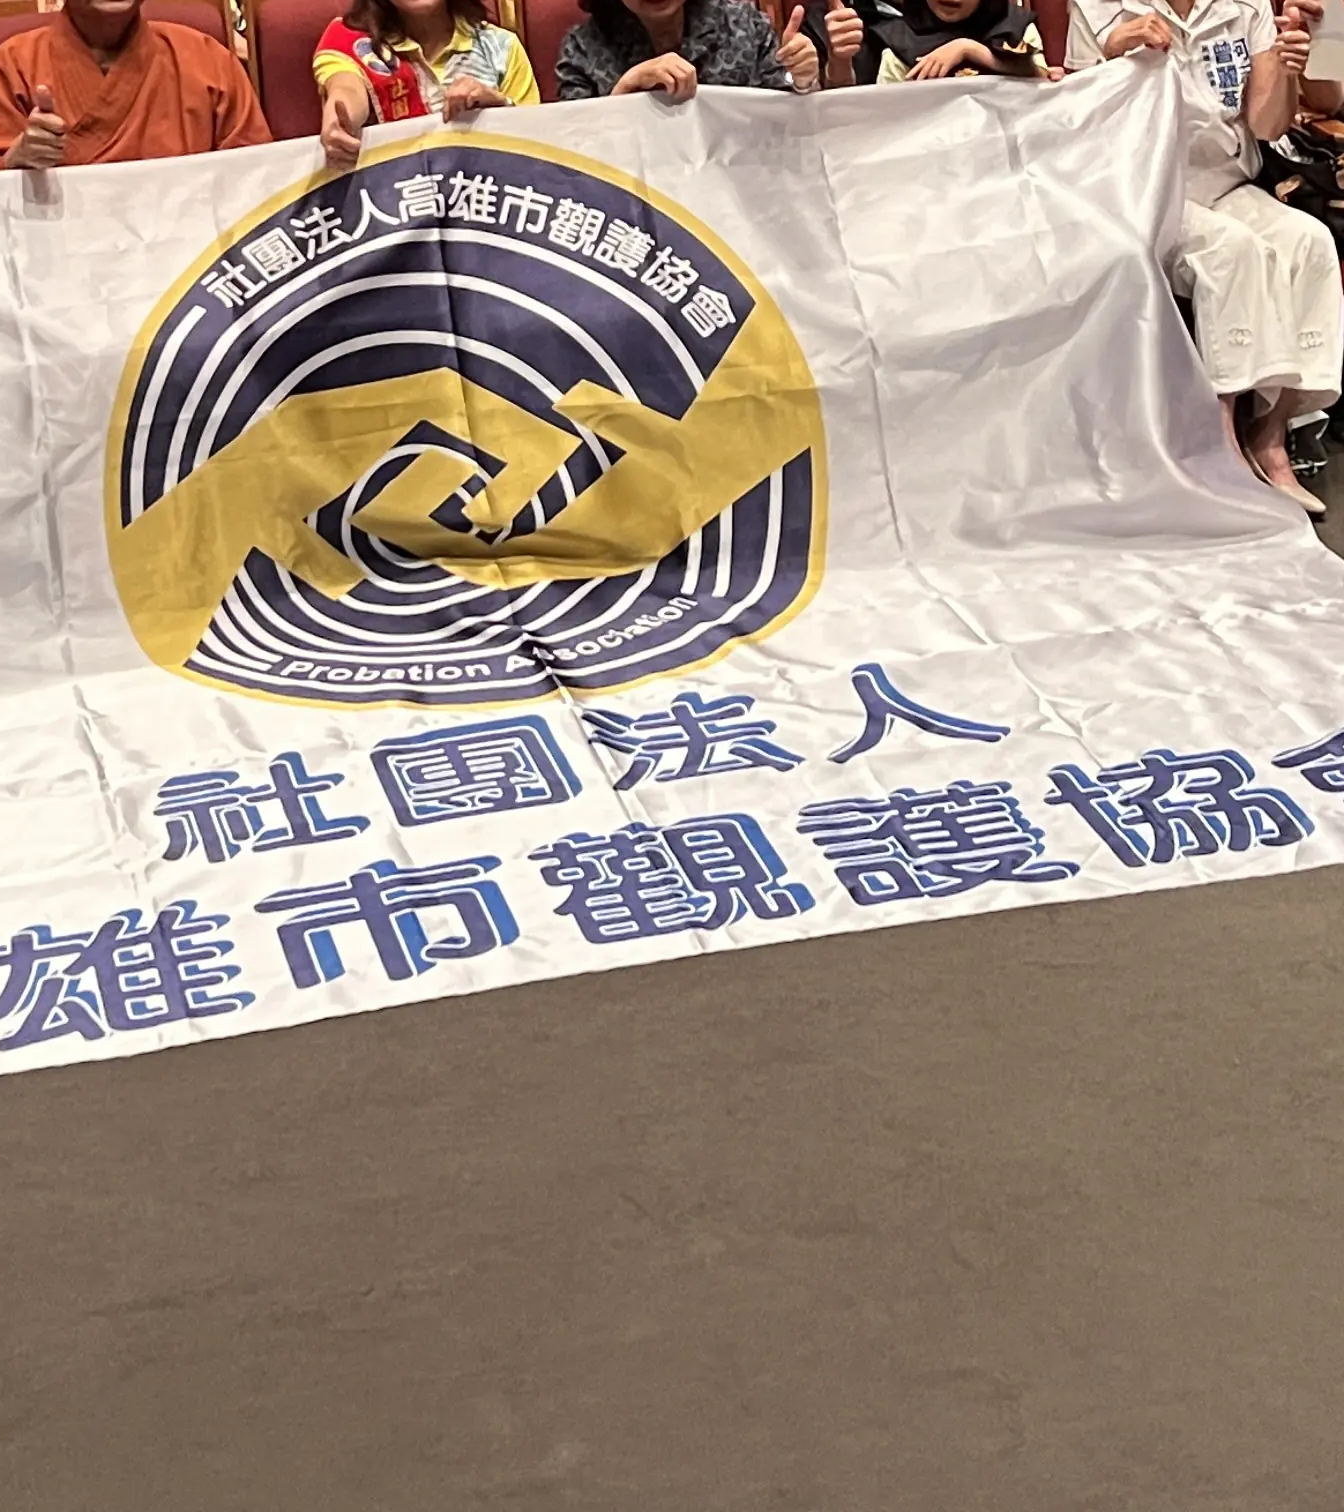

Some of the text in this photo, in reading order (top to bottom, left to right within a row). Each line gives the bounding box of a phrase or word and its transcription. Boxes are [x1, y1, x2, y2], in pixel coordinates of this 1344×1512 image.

[201, 170, 738, 338] 社團法人高雄市觀護協會
[280, 660, 492, 683] Probation
[159, 662, 1011, 864] 社團法人
